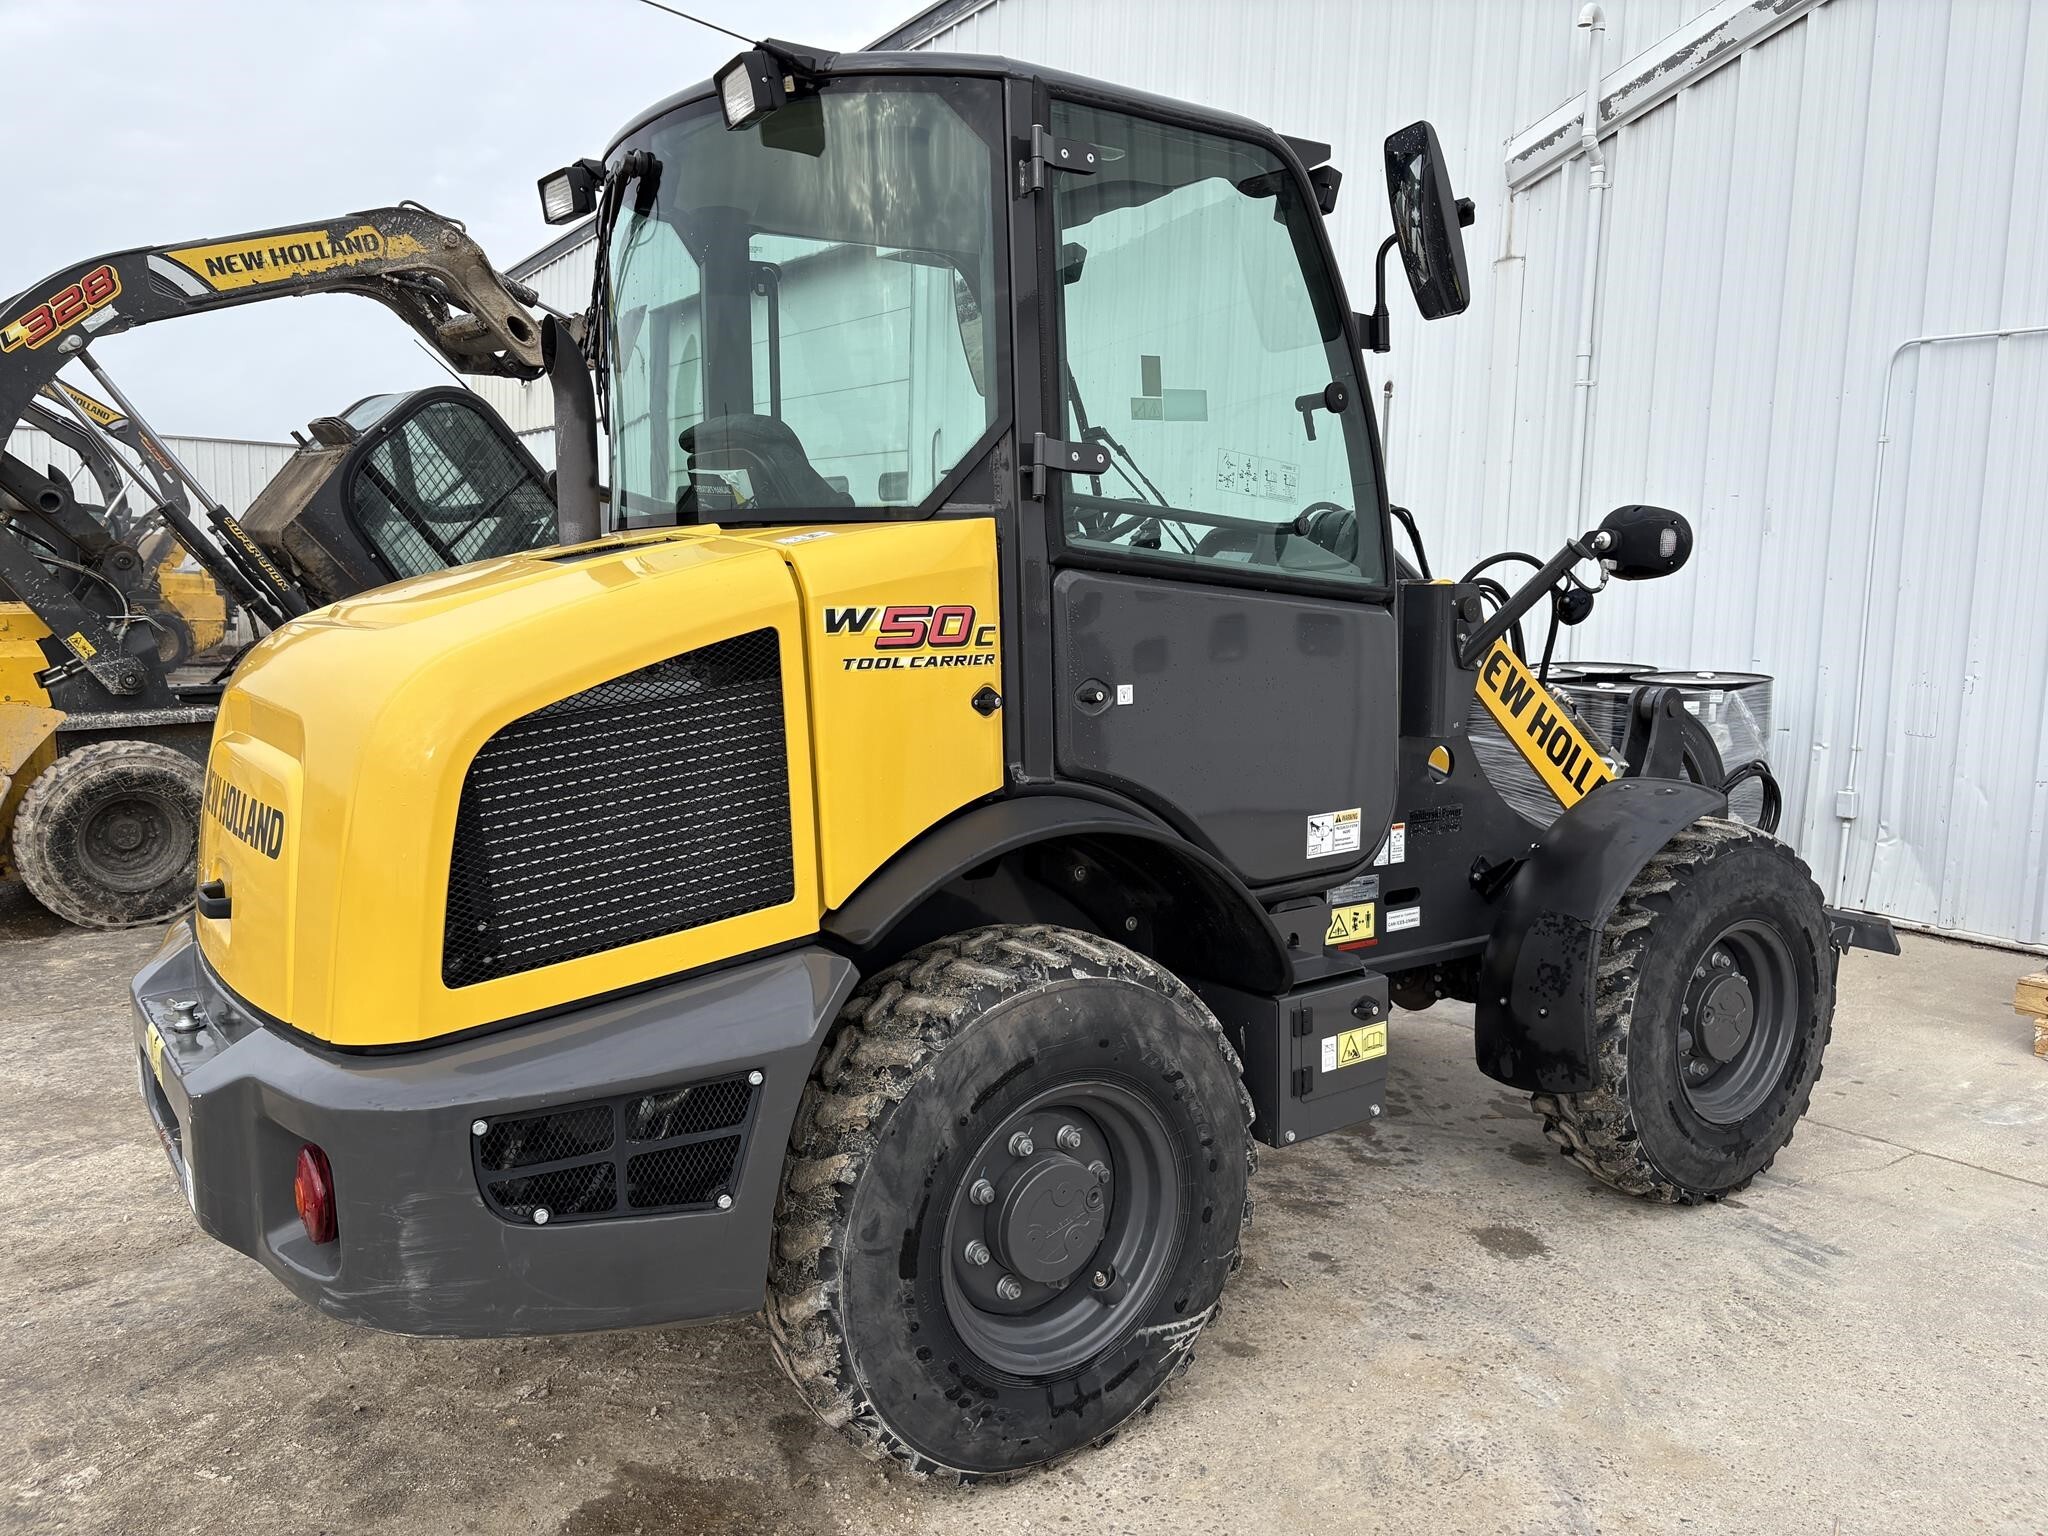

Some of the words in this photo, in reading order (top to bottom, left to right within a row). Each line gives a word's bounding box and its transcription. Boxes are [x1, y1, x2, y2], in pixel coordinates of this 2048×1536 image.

[204, 250, 264, 277] NEW
[268, 233, 380, 267] HOLLAND
[0, 266, 118, 350] L328
[70, 393, 111, 421] HOLLAND
[223, 516, 261, 557] SUPER
[843, 656, 904, 671] TOOL
[909, 654, 996, 669] CARRIER
[218, 779, 285, 860] HOLLAND
